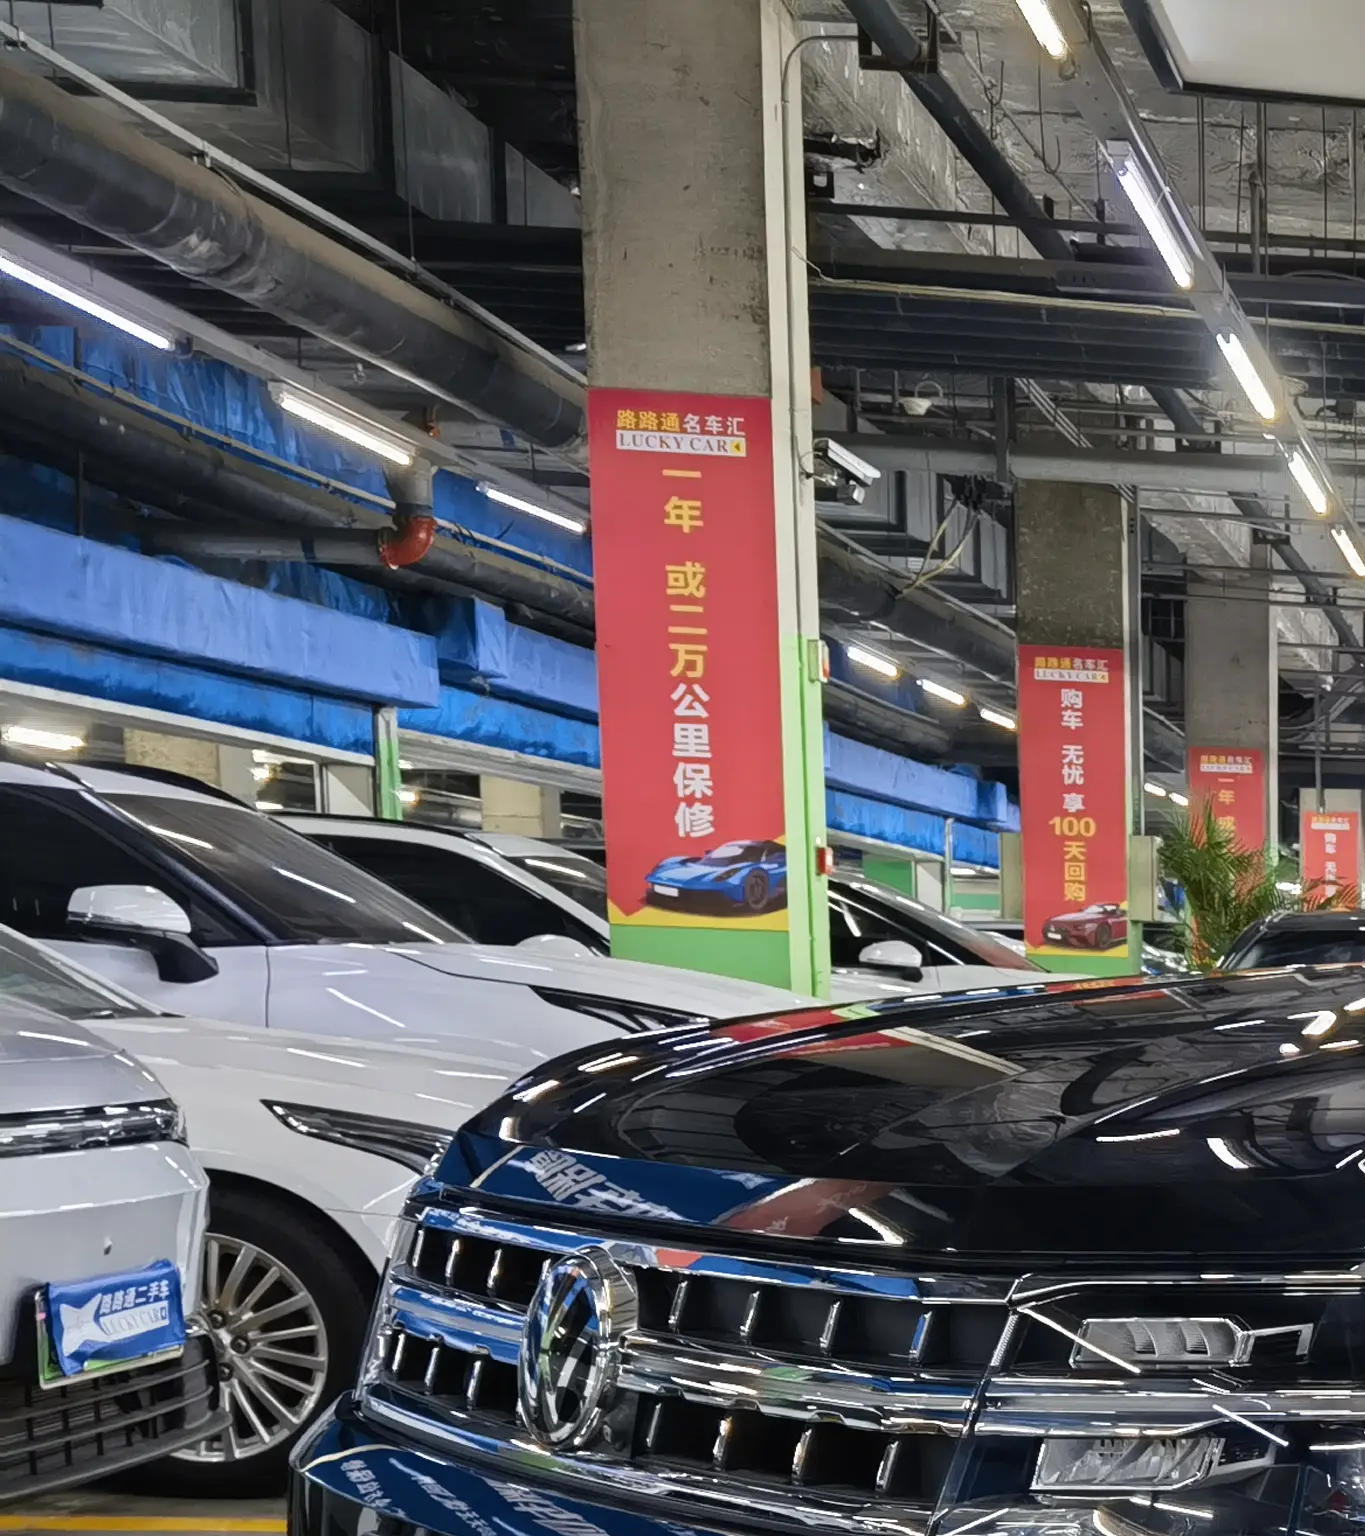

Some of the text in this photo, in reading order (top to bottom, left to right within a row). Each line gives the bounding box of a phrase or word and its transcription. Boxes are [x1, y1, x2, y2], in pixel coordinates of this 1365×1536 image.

[616, 409, 746, 436] 路路通名车汇
[619, 432, 729, 453] LUCKY CAR
